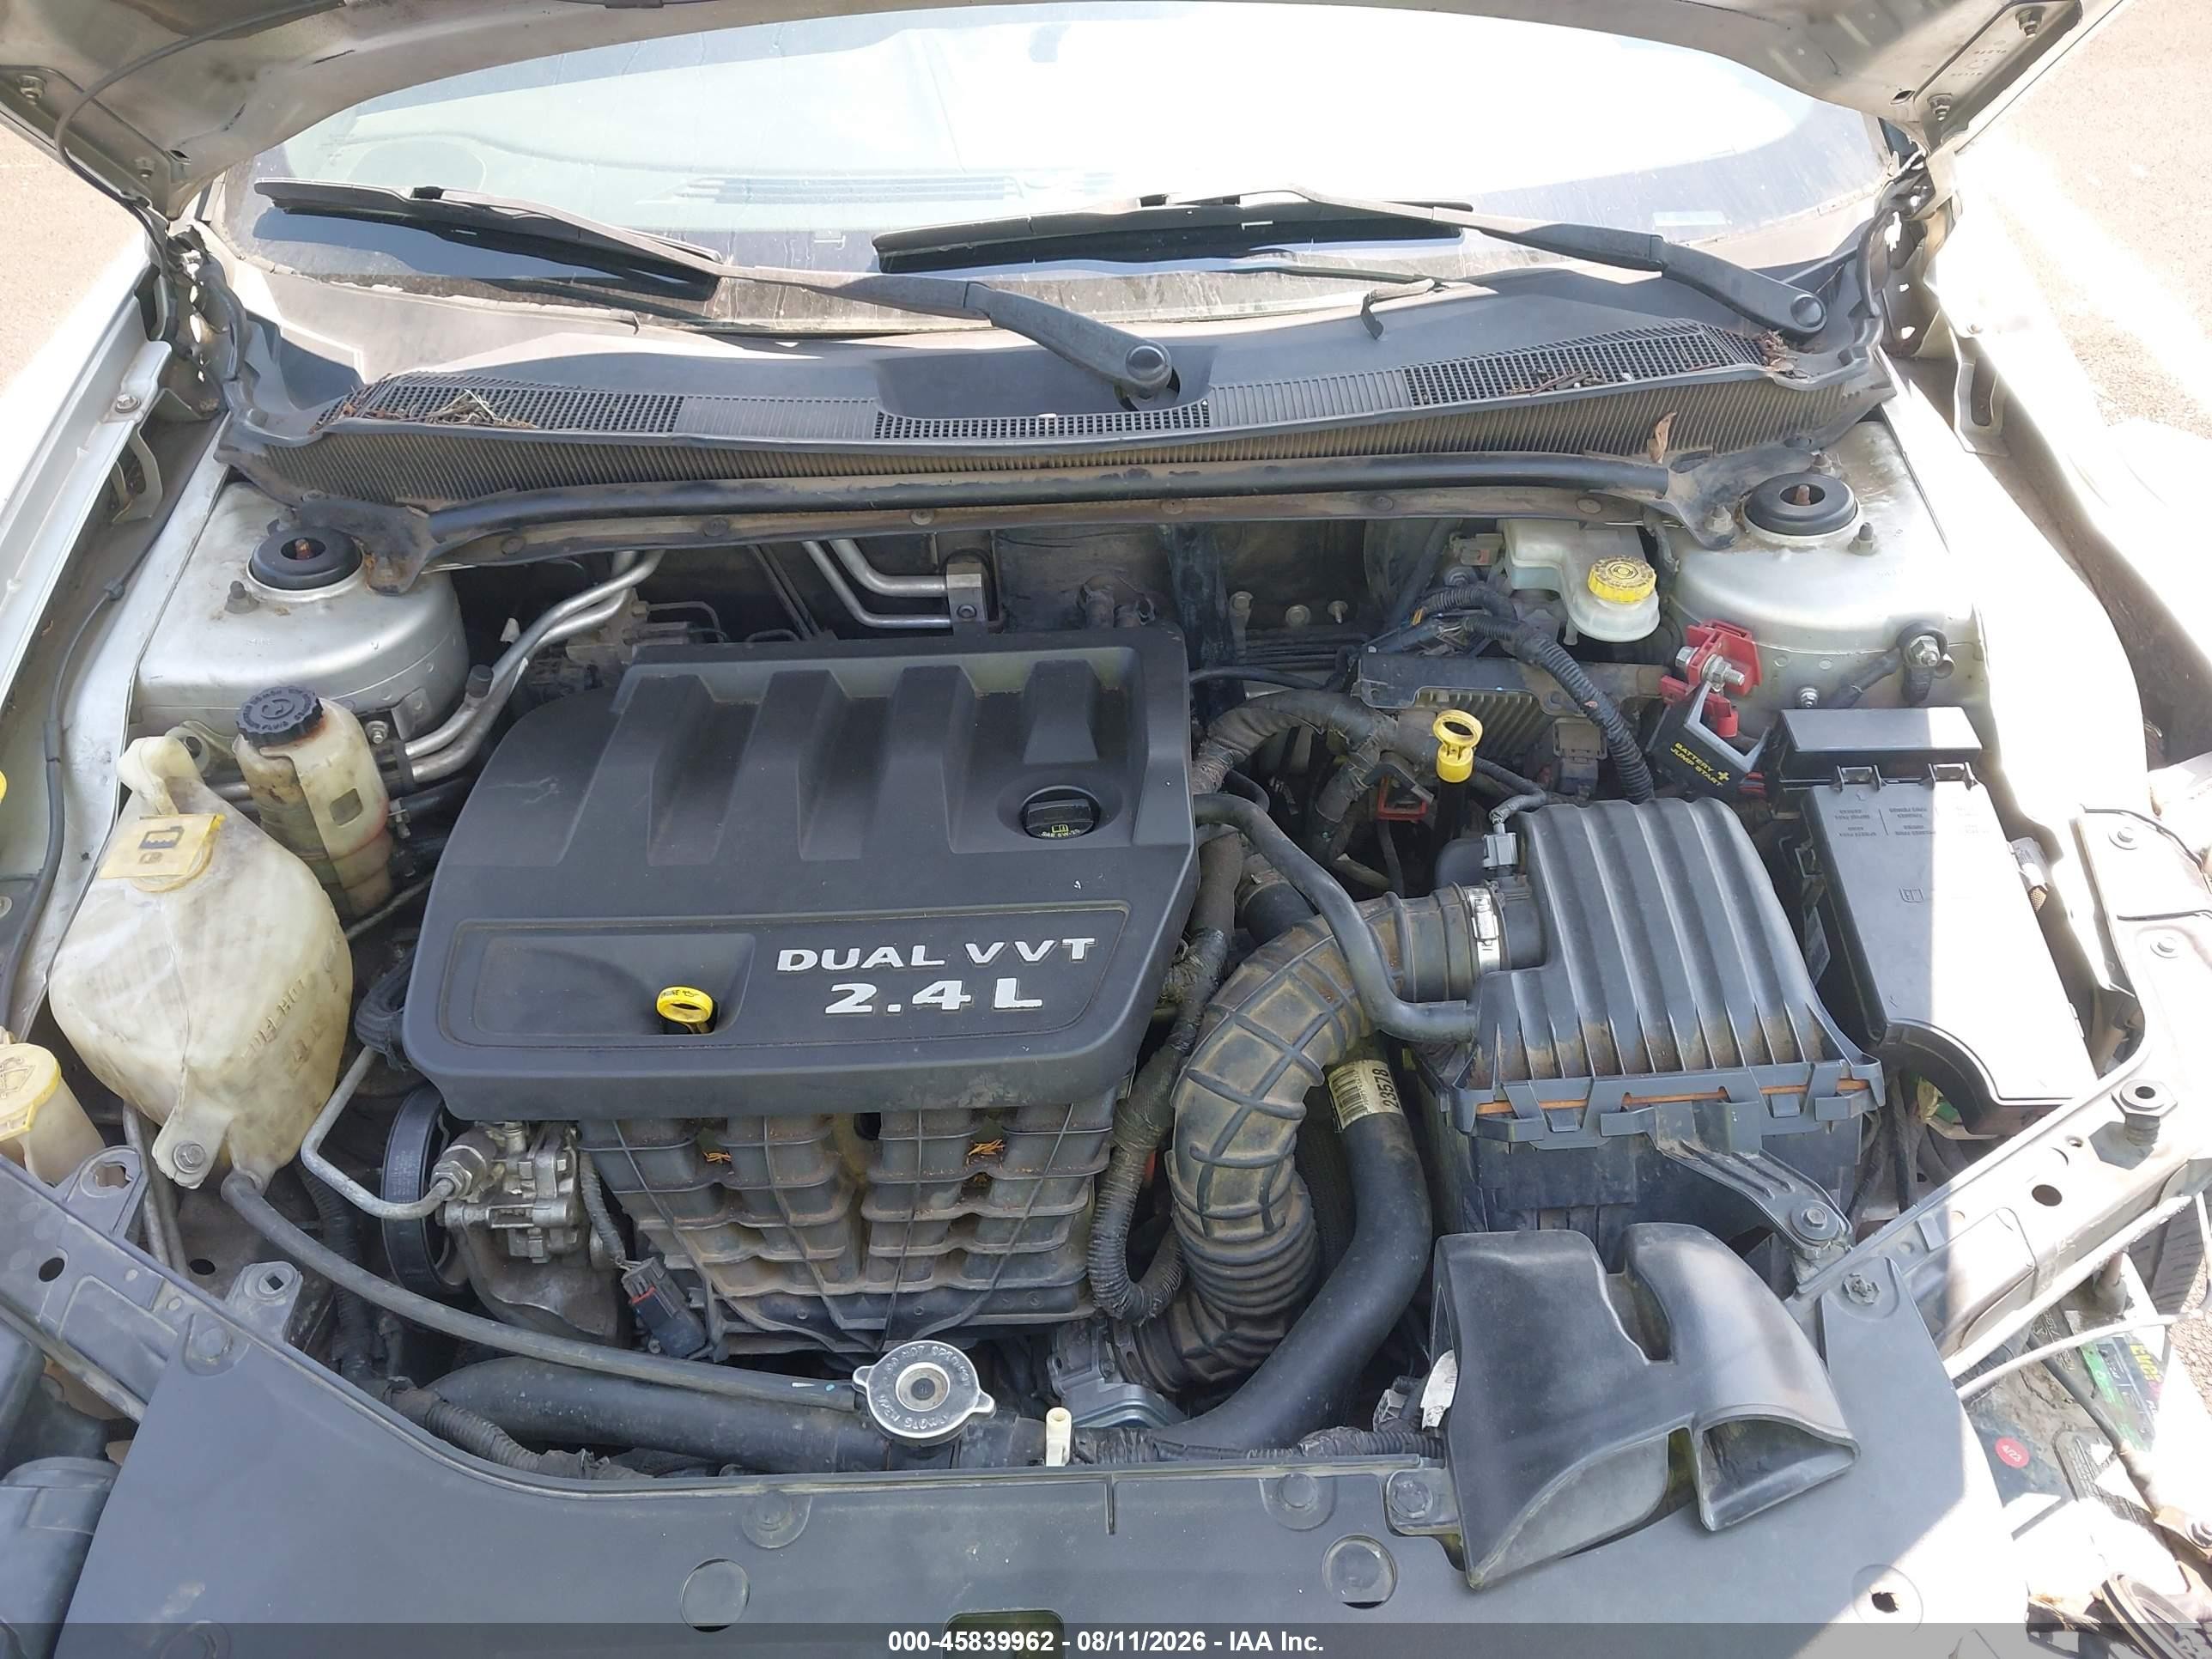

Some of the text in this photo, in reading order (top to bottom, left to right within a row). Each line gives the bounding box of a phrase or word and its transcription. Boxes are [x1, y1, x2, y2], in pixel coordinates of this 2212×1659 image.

[1670, 747, 1723, 787] JUMP START
[1674, 742, 1715, 772] BATTERY
[776, 937, 1097, 971] DUAL VVT
[1372, 1067, 1400, 1109] 23578
